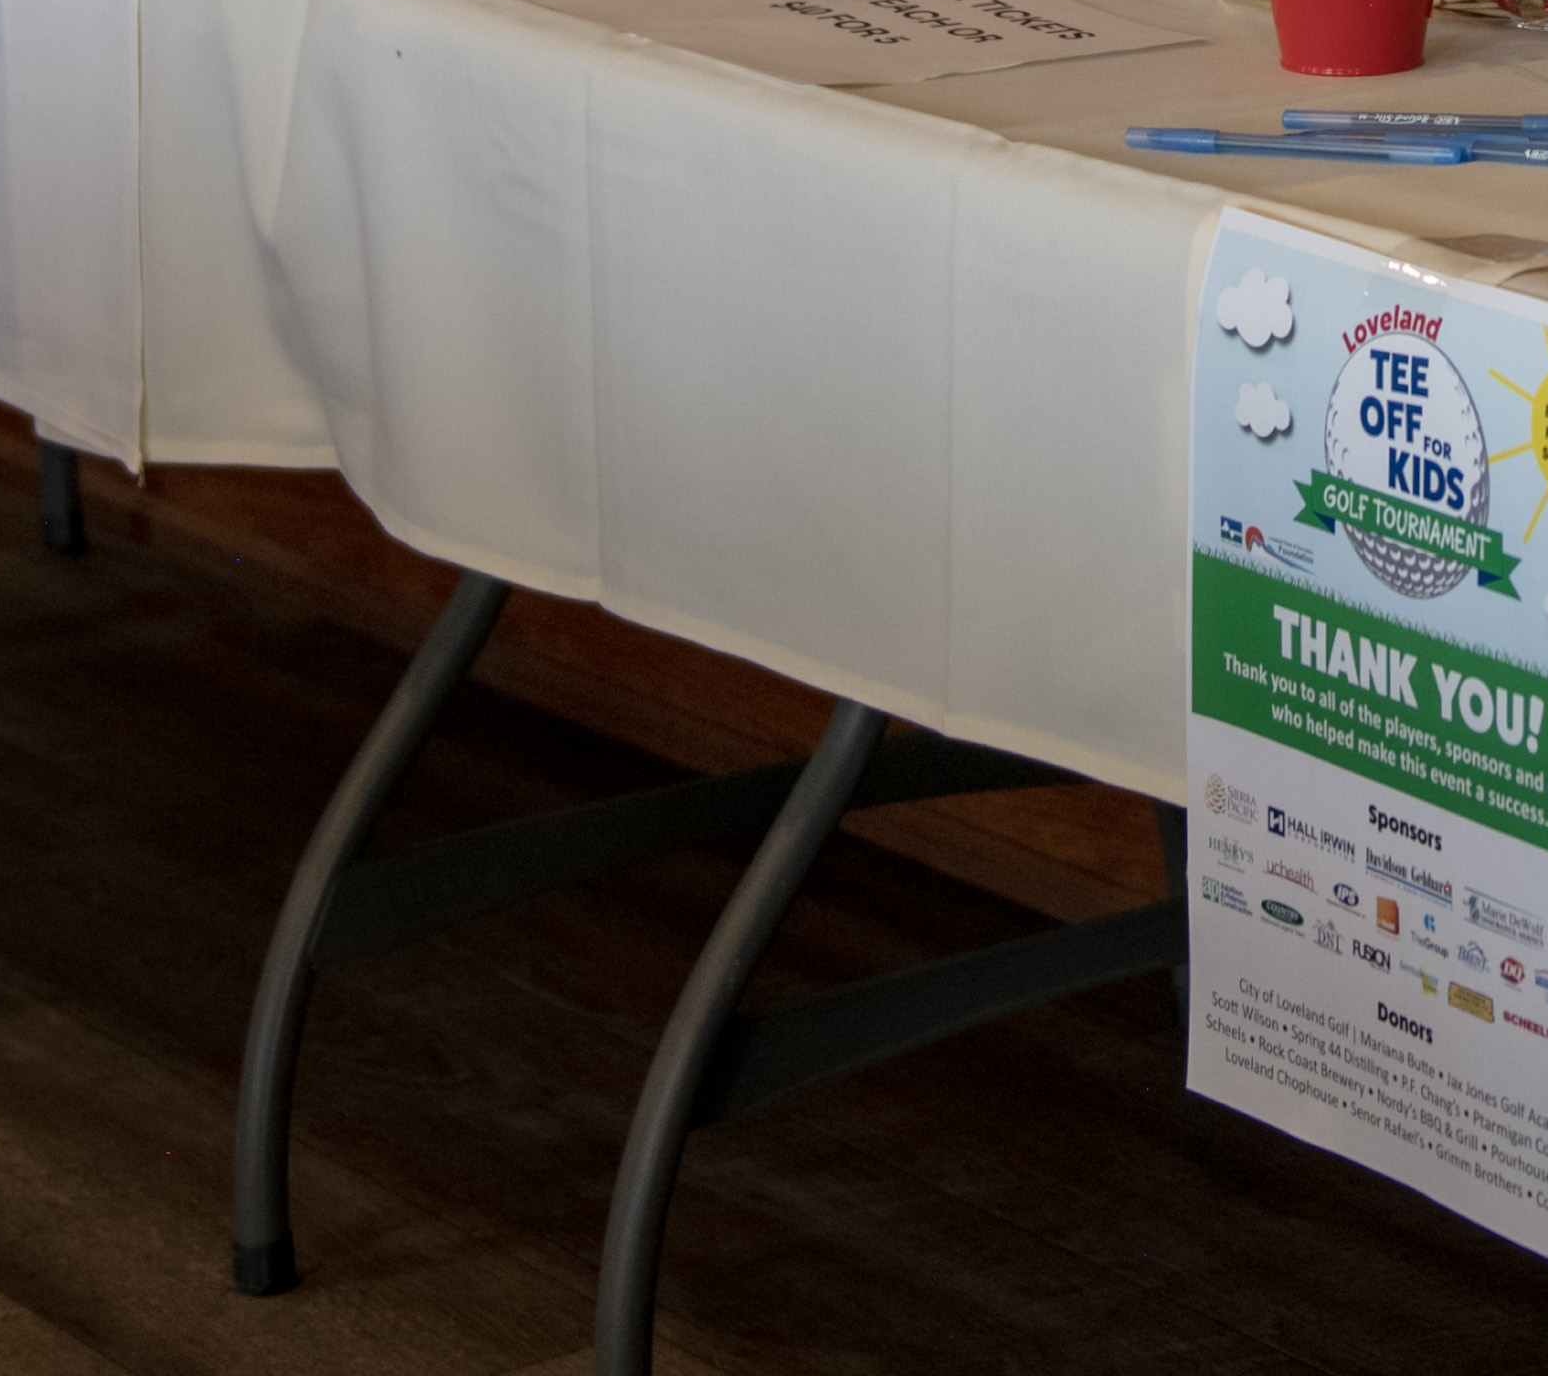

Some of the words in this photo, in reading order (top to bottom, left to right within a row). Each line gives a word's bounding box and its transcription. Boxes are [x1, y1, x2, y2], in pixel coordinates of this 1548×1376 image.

[817, 13, 891, 39] FOR
[948, 27, 1003, 44] OR
[971, 0, 1097, 41] TICKETS
[1343, 304, 1443, 354] Loveland
[1370, 349, 1430, 398] TEE
[1360, 396, 1423, 445] OFF
[1424, 436, 1452, 461] FOR
[1388, 447, 1465, 511] KIDS
[1323, 484, 1366, 519] GOLF
[1372, 496, 1492, 561] TOURNAMENT
[1273, 604, 1418, 710] THANK
[1431, 662, 1545, 755] YOU!
[1223, 652, 1268, 686] Thank
[1271, 673, 1297, 697] you
[1301, 681, 1316, 703] to
[1319, 689, 1336, 712] all
[1339, 699, 1355, 718] of
[1358, 705, 1381, 730] the
[1385, 716, 1441, 757] players,
[1445, 741, 1512, 781] sponsors
[1515, 769, 1544, 793] and
[1272, 703, 1302, 729] who
[1306, 712, 1354, 750] helped
[1358, 737, 1397, 767] make
[1400, 752, 1427, 780] this
[1430, 767, 1472, 797] event
[1288, 816, 1318, 841] HALL
[1320, 829, 1356, 857] IRWIN
[1368, 804, 1443, 852] Sponsors
[1266, 859, 1315, 892] uchealth
[1378, 1001, 1433, 1045] Donors
[1205, 1013, 1247, 1044] Scheels
[1258, 1035, 1286, 1061] Rock
[1287, 1048, 1319, 1075] Coast
[1320, 1062, 1365, 1099] Brewery
[1212, 991, 1239, 1017] Scott
[1242, 1003, 1279, 1032] Wilson
[1291, 1024, 1326, 1056] Spring
[1473, 1110, 1533, 1150] Ptarmigan
[1239, 977, 1259, 1002] City
[1277, 993, 1325, 1027] Loveland
[1360, 1031, 1405, 1063] Mariana
[1407, 1051, 1436, 1079] Butte
[1466, 1081, 1498, 1109] Jones
[1501, 1096, 1526, 1119] Golf
[1225, 1047, 1274, 1080] Loveland
[1276, 1069, 1339, 1109] Chophouse
[1351, 1100, 1382, 1128] Senor
[1436, 1143, 1472, 1173] Grimm
[1475, 1162, 1523, 1198] Brothers
